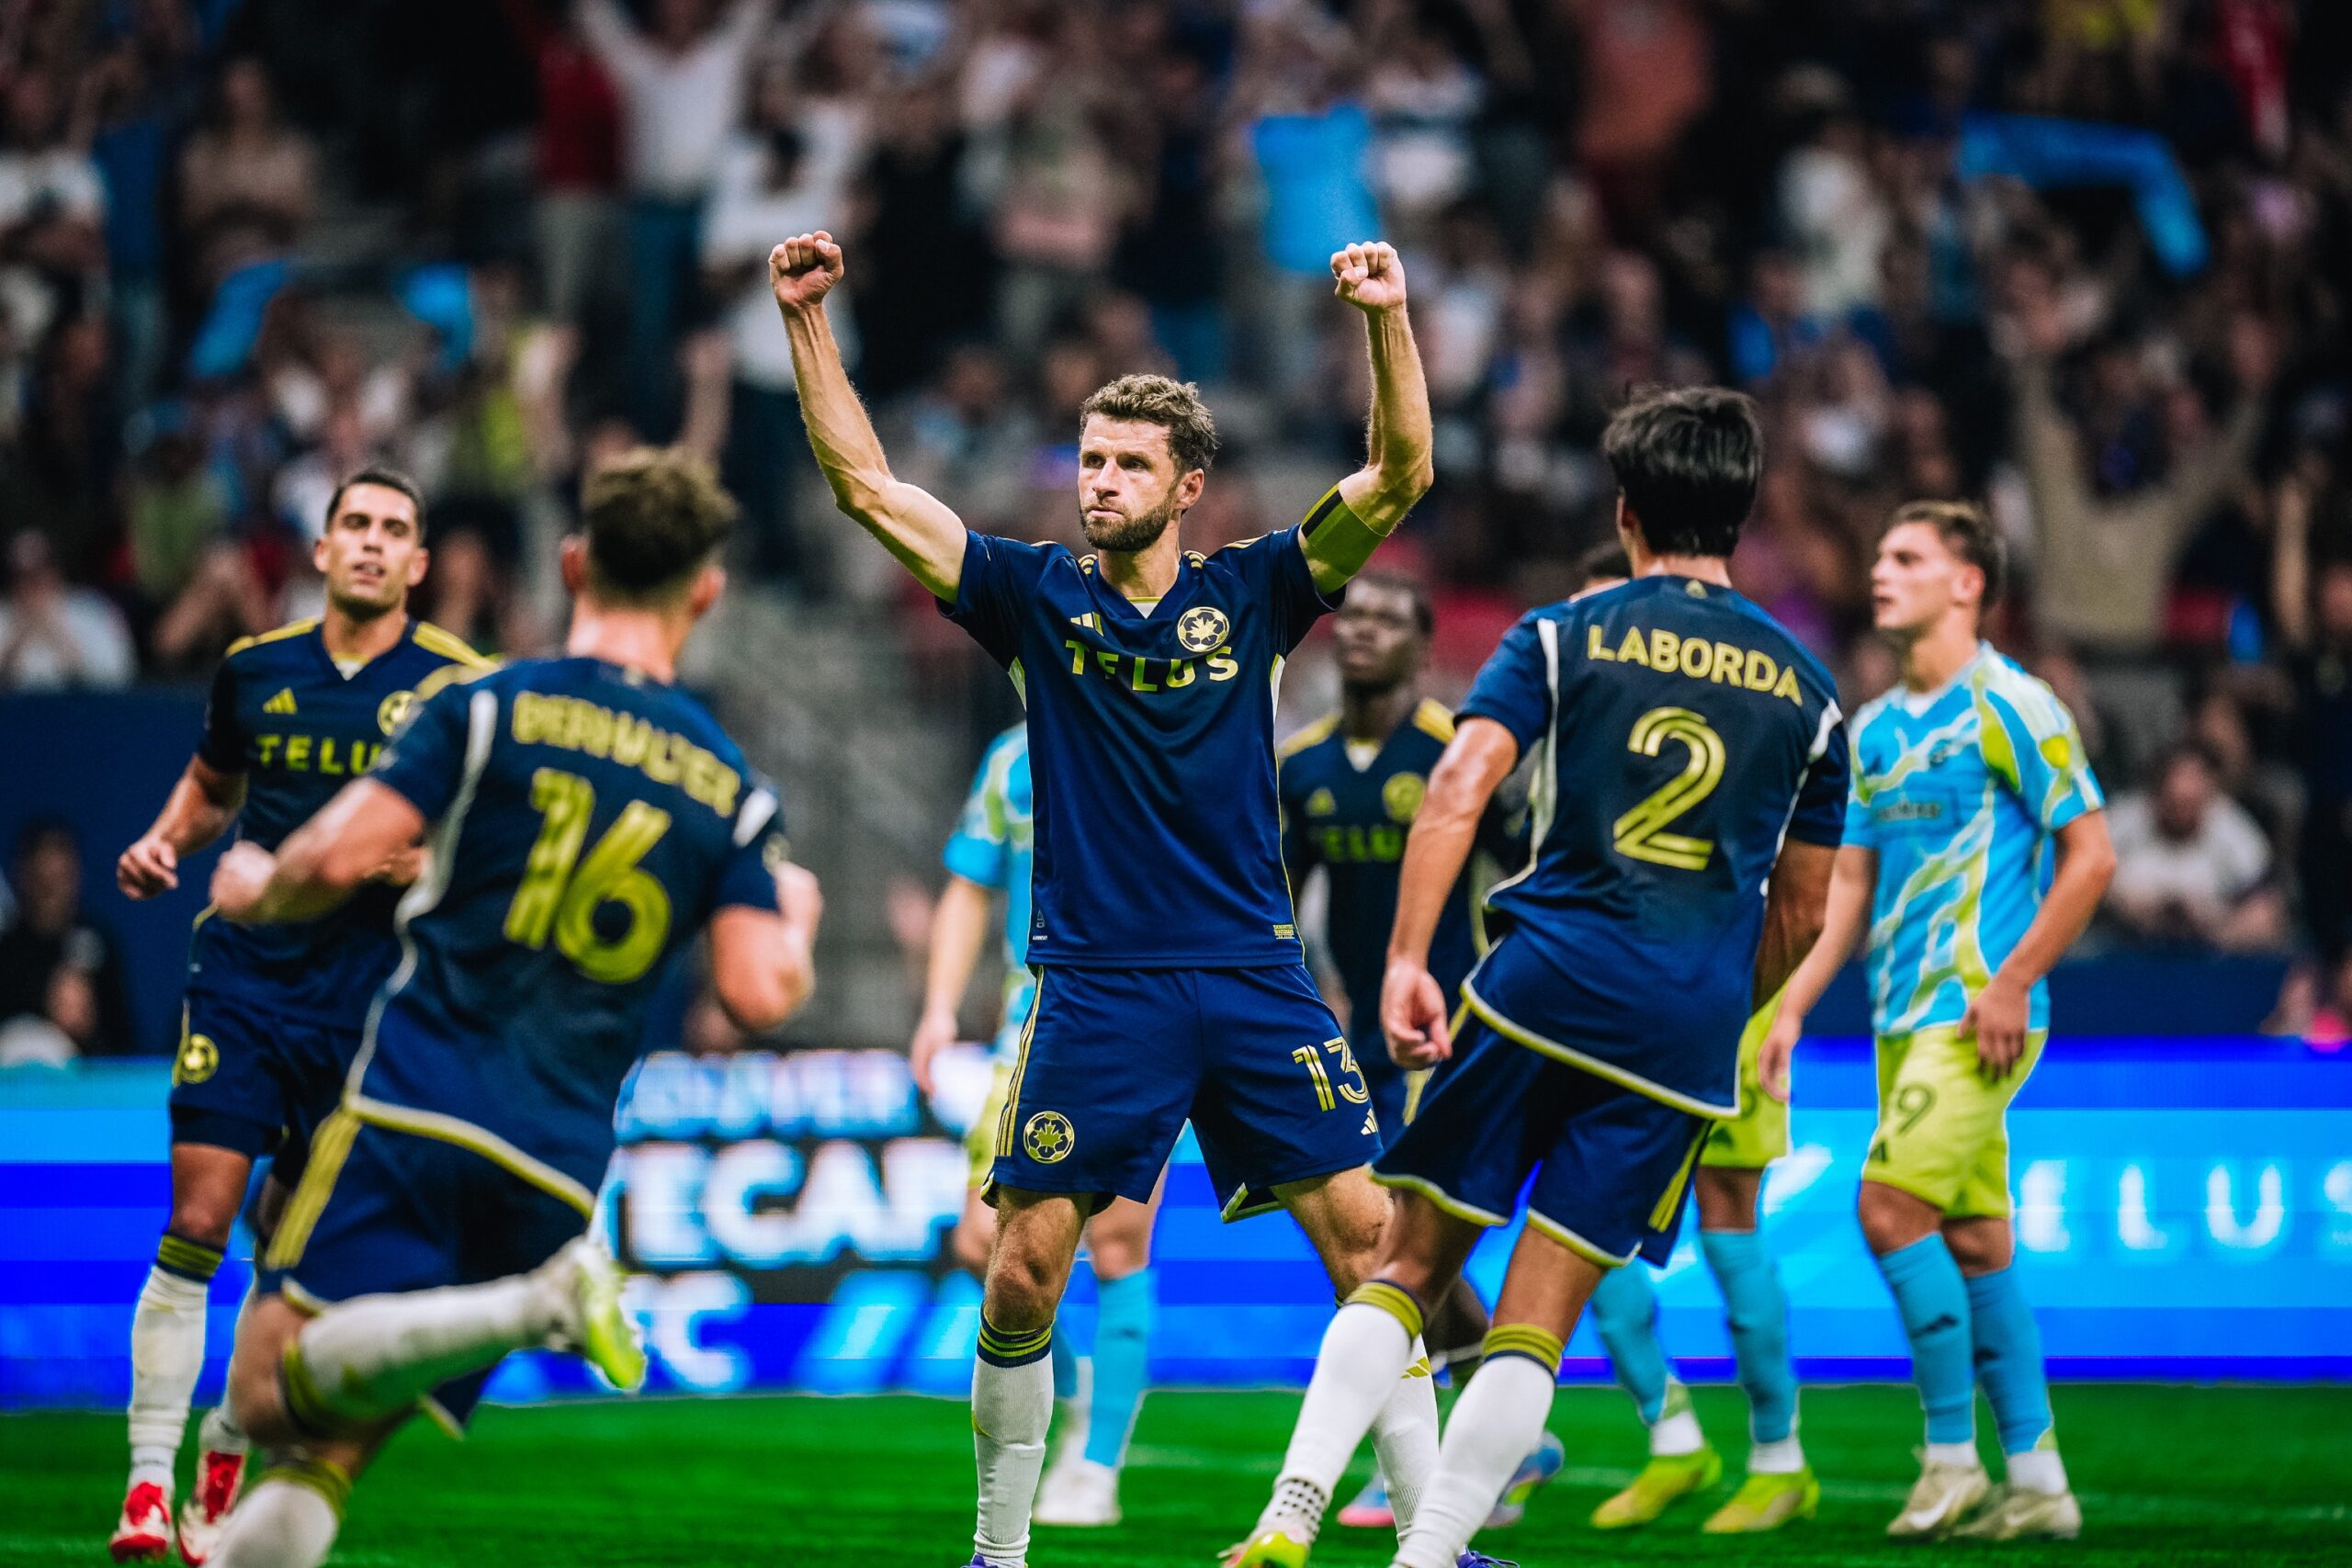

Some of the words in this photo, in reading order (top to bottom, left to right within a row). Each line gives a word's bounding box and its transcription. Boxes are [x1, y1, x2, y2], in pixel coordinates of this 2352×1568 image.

[1066, 639, 1238, 692] TELUS
[1588, 625, 1803, 706] LABORDA
[1612, 705, 1726, 871] 2
[504, 767, 673, 985] 16
[1292, 1035, 1371, 1112] 13
[1895, 1081, 1938, 1138] 9
